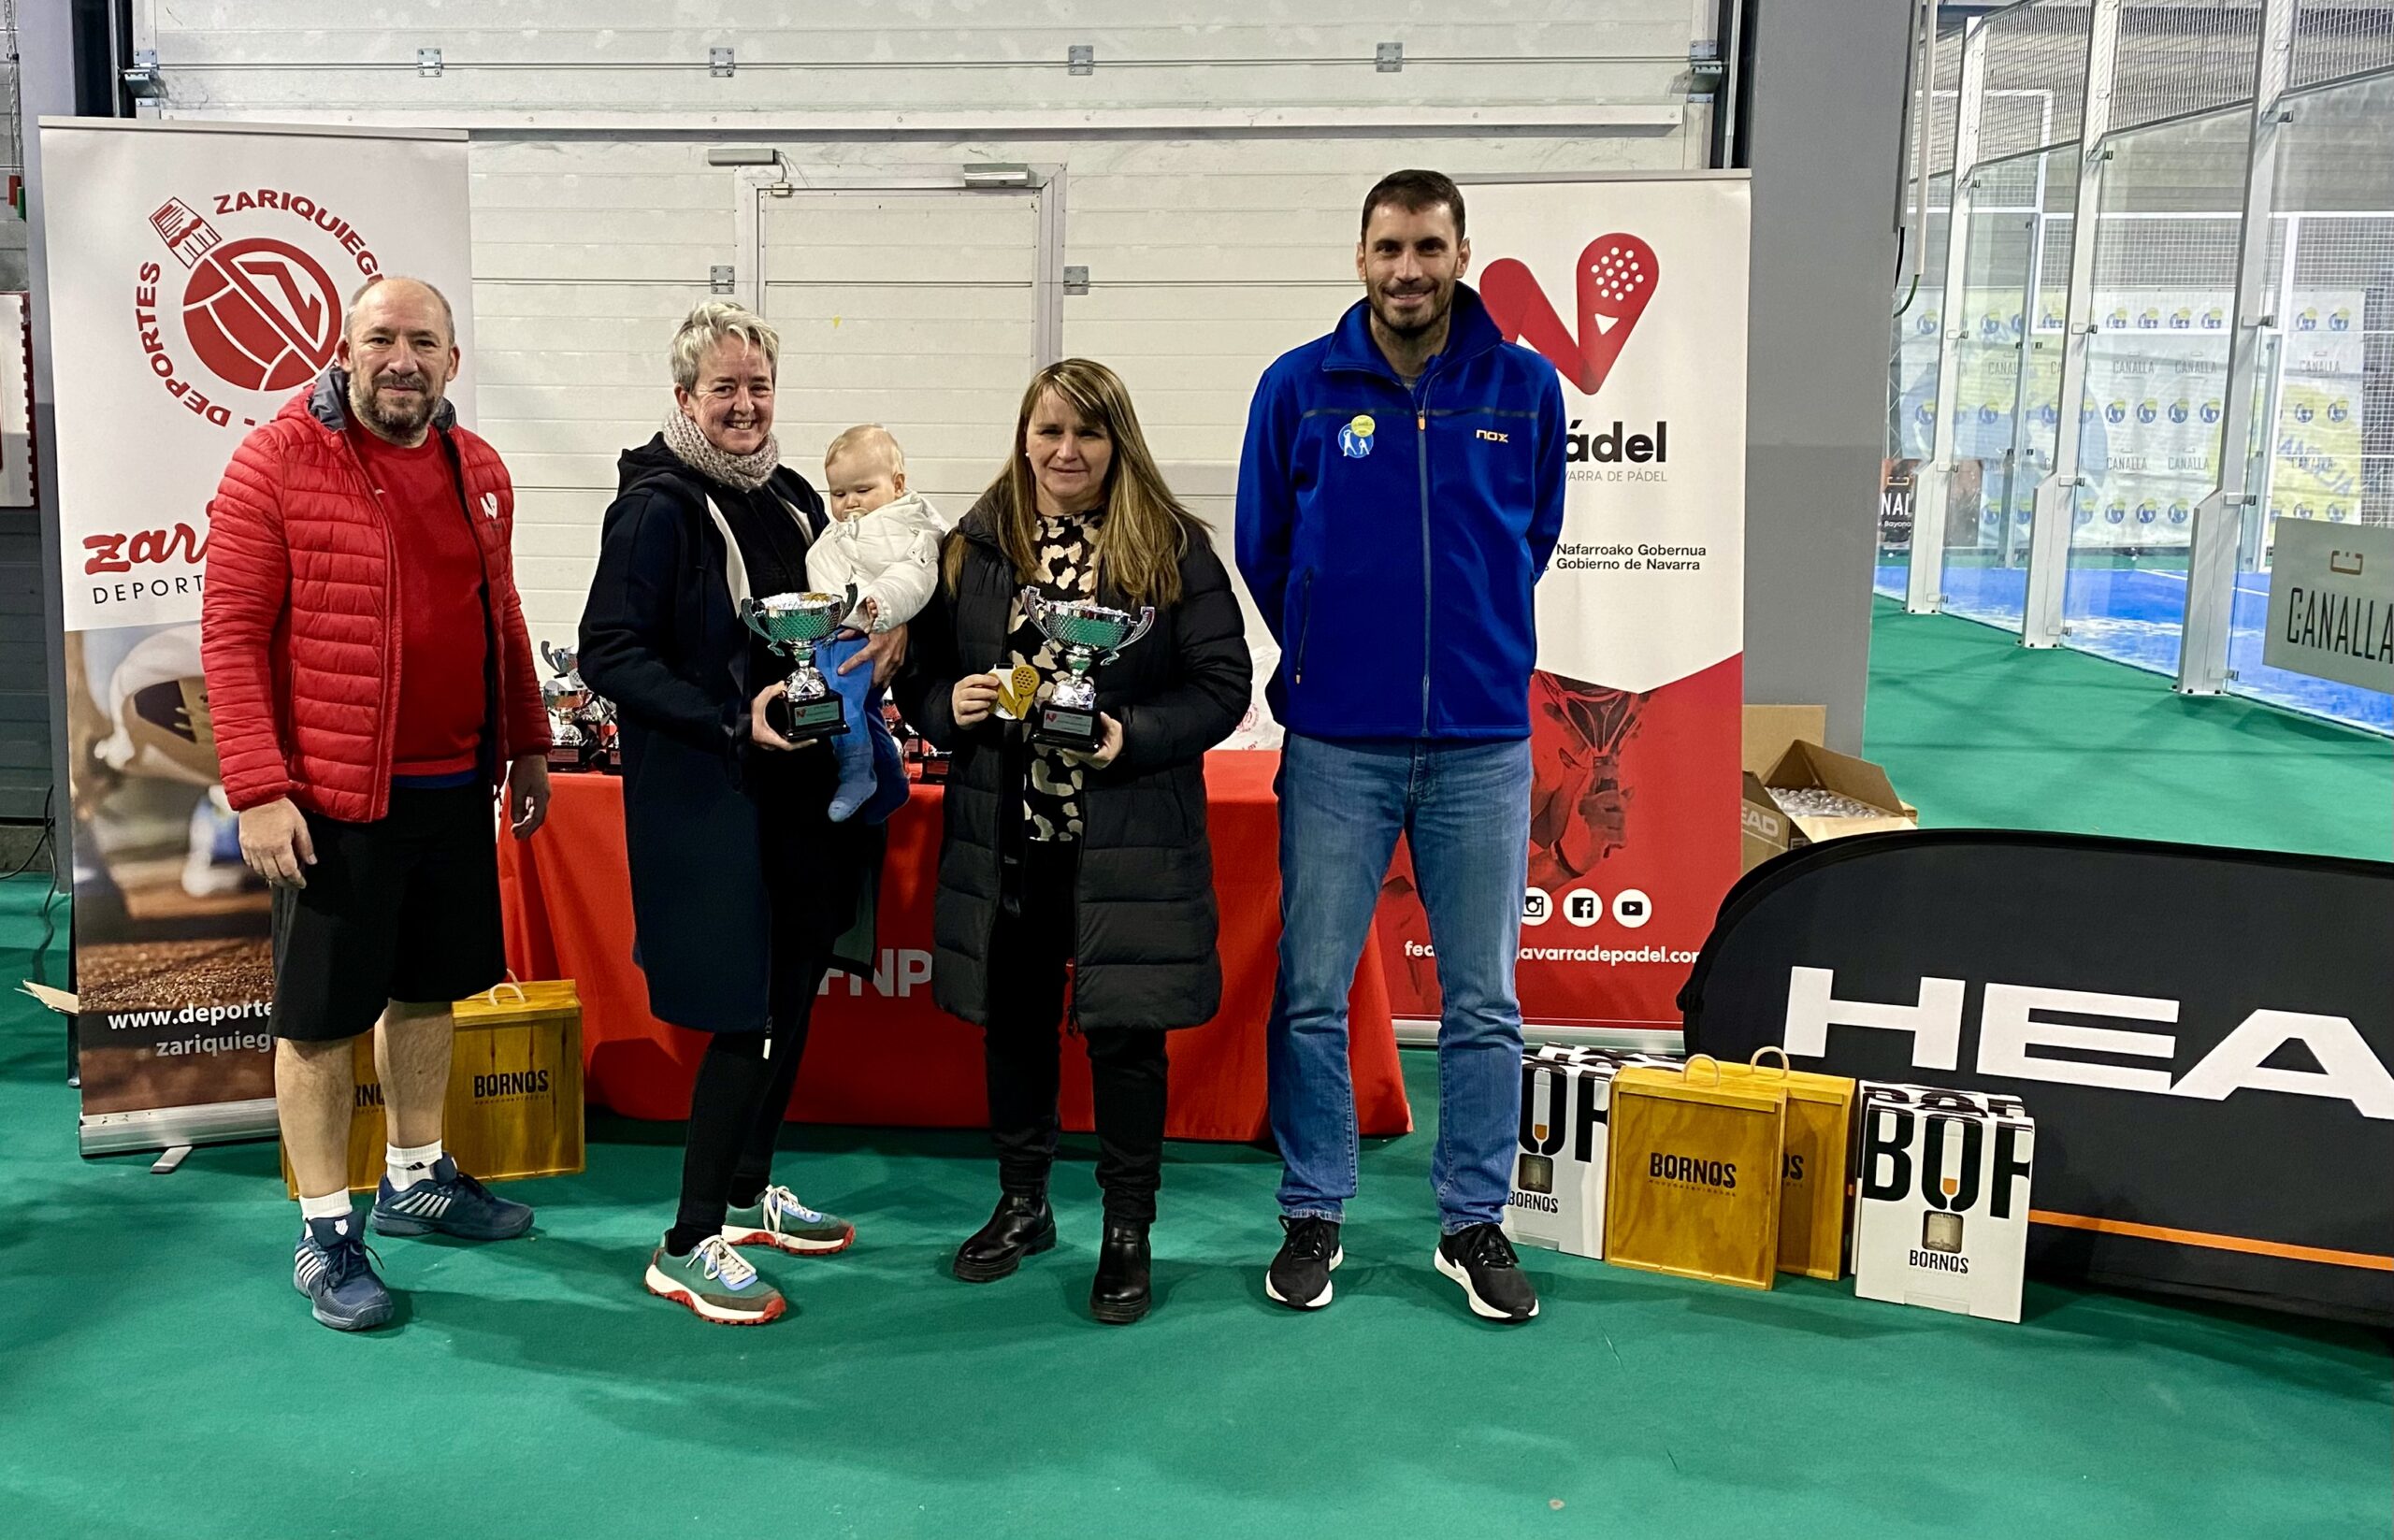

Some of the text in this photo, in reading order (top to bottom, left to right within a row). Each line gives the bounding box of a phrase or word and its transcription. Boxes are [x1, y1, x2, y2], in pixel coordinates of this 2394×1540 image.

[213, 189, 383, 281] ZARIQUIEG
[136, 261, 231, 427] DEPORTES
[2113, 360, 2154, 374] CANALLA
[2175, 361, 2217, 374] CANALLA
[1607, 470, 1623, 482] DE
[1627, 468, 1667, 482] PÁDEL
[82, 505, 211, 575] zar
[1556, 543, 1707, 556] Nafarroako Gobernua
[1556, 558, 1700, 570] Gobierno de Navarra
[2286, 586, 2394, 665] CANALLA
[155, 1029, 279, 1058] zariquieg
[473, 1069, 550, 1099] BORNOS
[1649, 1152, 1737, 1189] BORNOS
[1507, 1190, 1559, 1214] BORNOS
[1909, 1249, 1969, 1274] BORNOS
